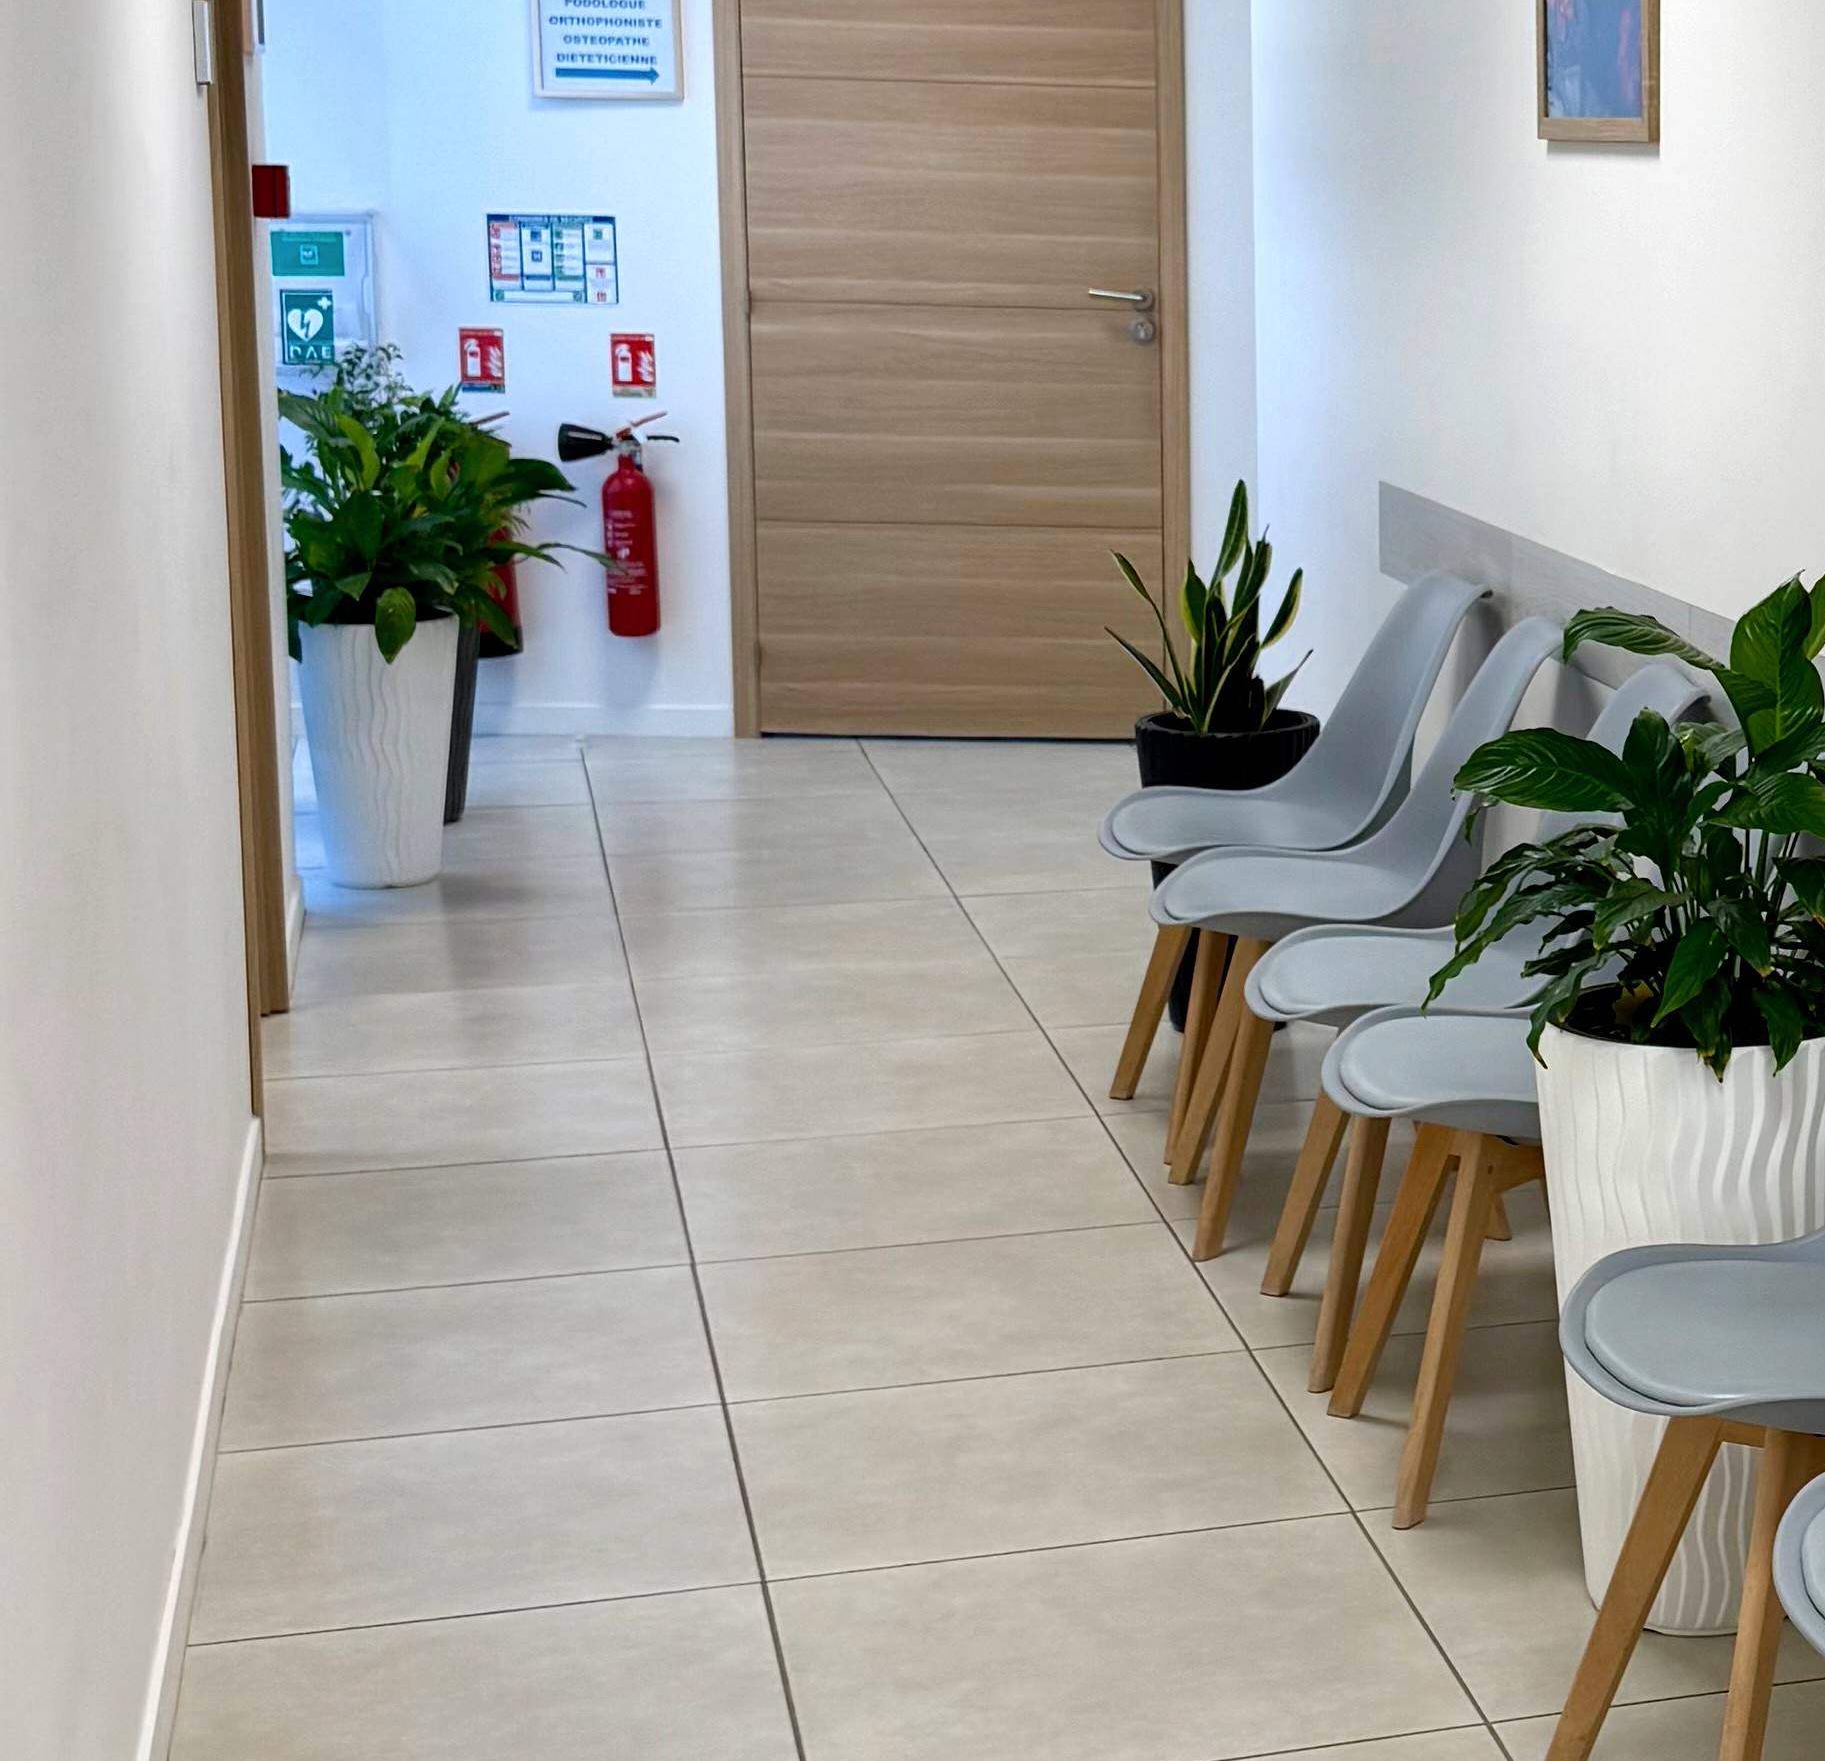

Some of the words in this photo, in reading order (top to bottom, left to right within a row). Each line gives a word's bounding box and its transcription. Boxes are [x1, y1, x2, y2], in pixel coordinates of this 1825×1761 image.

[549, 16, 663, 29] ORTHOPHONISTE
[563, 35, 650, 47] OSTEOPATHE
[289, 345, 332, 360] DAE
